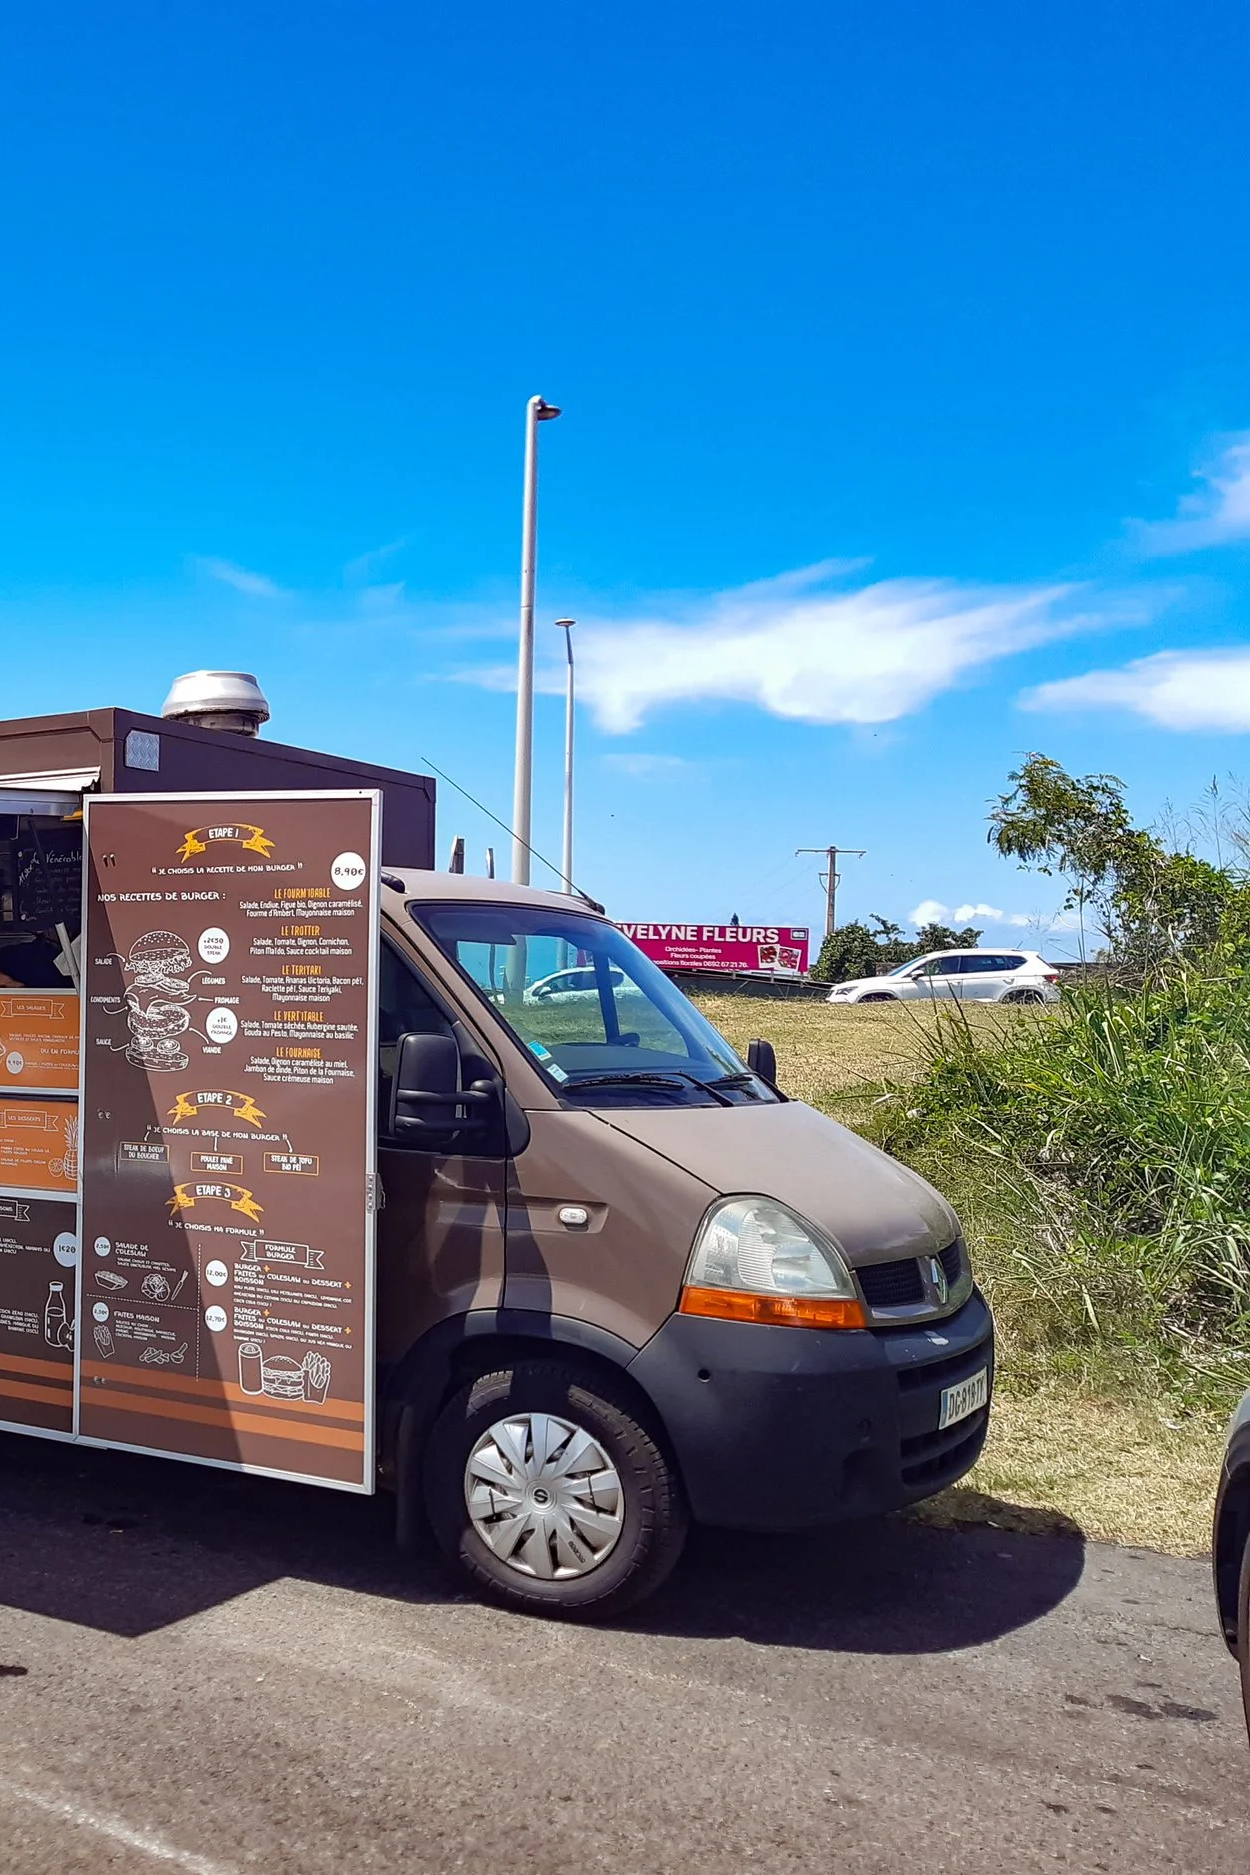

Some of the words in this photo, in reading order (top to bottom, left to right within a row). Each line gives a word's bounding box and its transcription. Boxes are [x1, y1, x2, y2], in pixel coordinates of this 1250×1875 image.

[208, 827, 233, 839] ETAPE
[158, 867, 166, 875] JE
[168, 867, 194, 875] CHOISIS
[207, 865, 234, 873] RECETTE
[236, 865, 246, 873] DE
[247, 864, 264, 872] MON
[266, 863, 295, 872] BURGER
[97, 894, 117, 902] NOS
[119, 893, 162, 902] RECETTES
[165, 892, 178, 901] DE
[181, 891, 220, 900] BURGER
[274, 888, 282, 899] LE
[296, 909, 331, 918] Mayonnaise
[332, 908, 355, 917] maison
[281, 926, 288, 936] LE
[290, 925, 321, 936] TROTTER
[702, 927, 779, 943] FLEURS
[282, 965, 290, 975] LE
[292, 965, 322, 975] TERIYAKI
[272, 994, 308, 1003] Mayonnaise
[308, 994, 330, 1002] maison
[274, 1010, 281, 1021] LE
[276, 1047, 283, 1057] LE
[286, 1047, 321, 1058] FOURNAISE
[312, 1076, 334, 1085] maison
[197, 1093, 223, 1104] ETAPE
[225, 1094, 232, 1105] 2
[153, 1126, 161, 1134] JE
[162, 1127, 190, 1136] CHOISIS
[191, 1128, 199, 1136] LA
[201, 1129, 220, 1137] BASE
[233, 1131, 249, 1139] MON
[251, 1132, 280, 1141] BURGER
[195, 1185, 223, 1196] ETAPE
[225, 1187, 231, 1198] 3
[175, 1221, 183, 1229] JE
[184, 1222, 212, 1231] CHOISIS
[213, 1225, 223, 1233] MA
[225, 1226, 257, 1237] FORMULE
[264, 1244, 297, 1254] FORMULE
[233, 1263, 262, 1272] BURGER
[233, 1306, 262, 1316] BURGER
